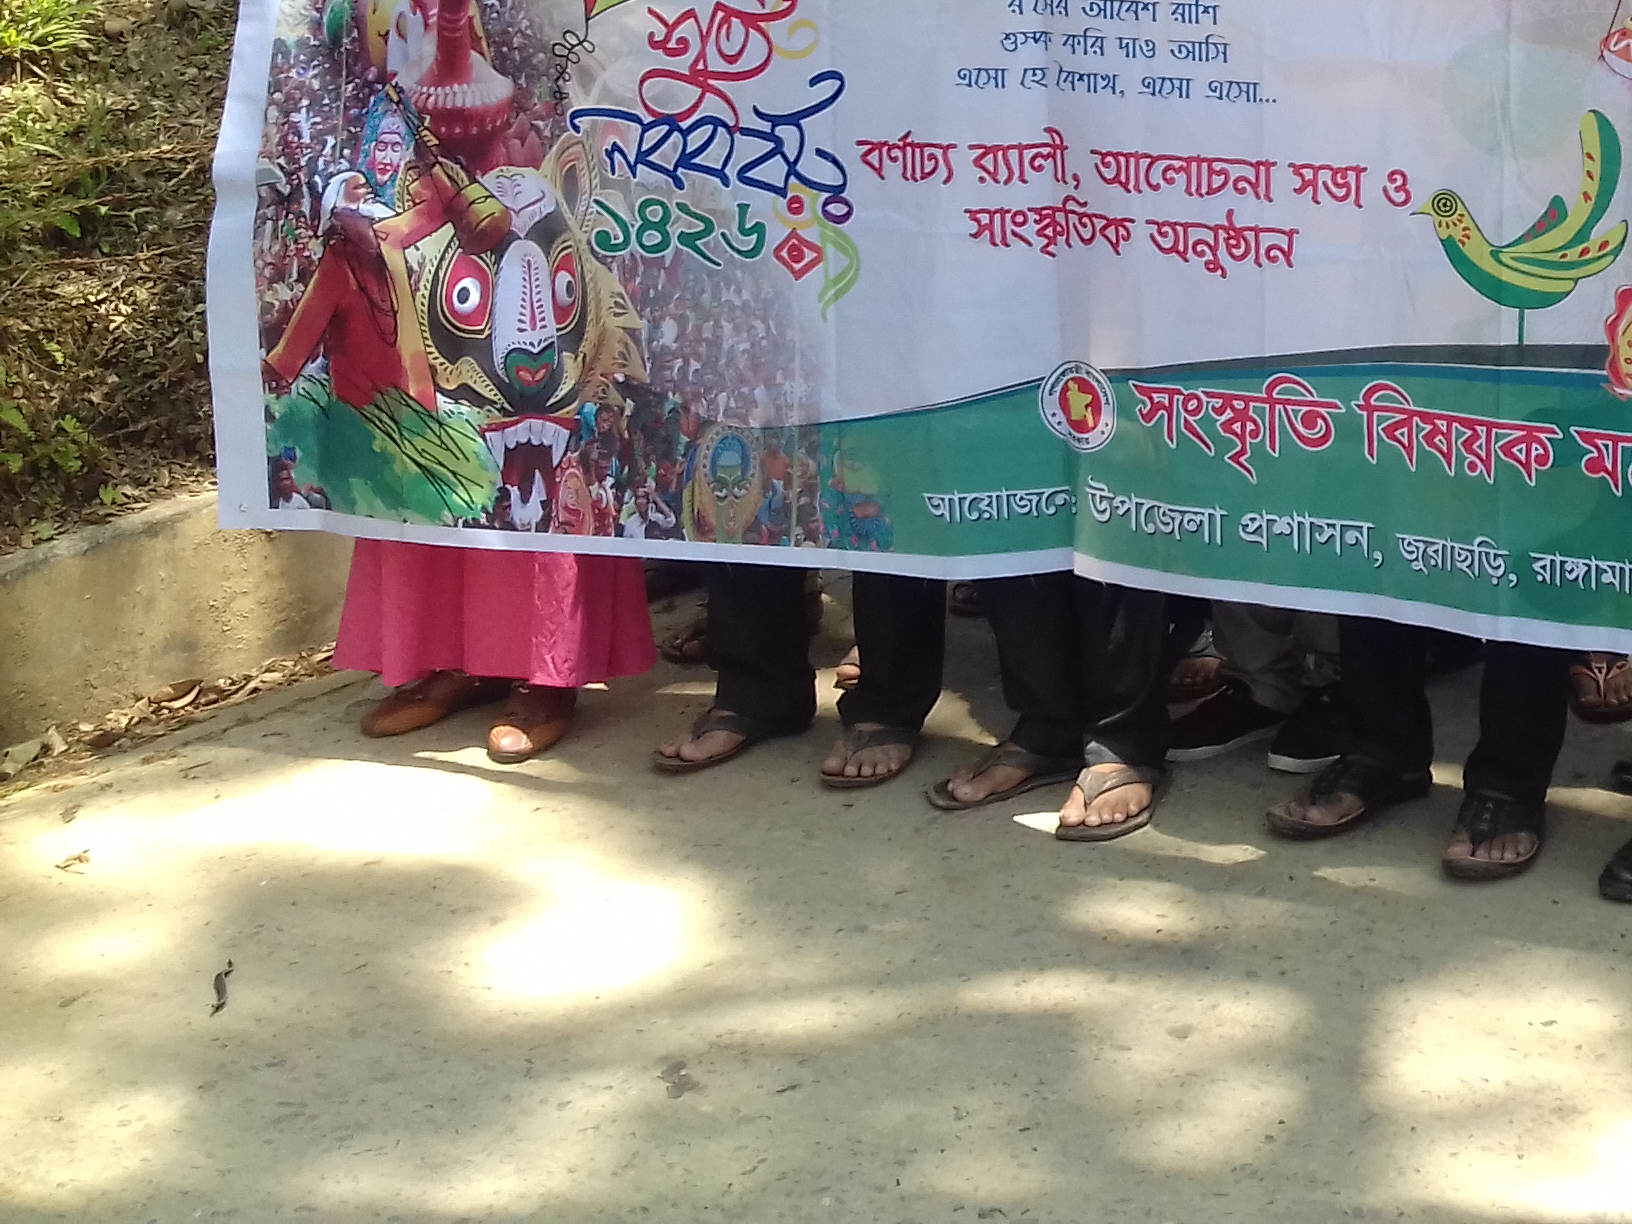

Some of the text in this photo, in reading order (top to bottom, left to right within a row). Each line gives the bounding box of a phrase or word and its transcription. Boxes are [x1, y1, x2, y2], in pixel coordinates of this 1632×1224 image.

[954, 66, 1009, 90] এসো
[1018, 67, 1050, 89] হে
[1055, 61, 1126, 98] বৈশাখ,
[1136, 76, 1194, 99] এসো
[1061, 27, 1109, 57] করি
[1115, 37, 1157, 58] দাও
[1166, 33, 1231, 64] আসি
[855, 129, 957, 186] বর্ণাঢ্য
[1090, 148, 1278, 204] আলোচনা
[1288, 161, 1369, 209] সভা
[1382, 167, 1414, 210] ও
[591, 195, 769, 269] ১৪২৬
[963, 195, 1300, 279] সাংস্কৃতিক অনুষ্ঠান
[1128, 373, 1346, 484] সংস্কৃতি
[1353, 381, 1564, 486] বিষয়ক
[922, 487, 1078, 523] আয়োজনে:
[1085, 476, 1228, 547] উপজেলা
[1238, 509, 1384, 568] প্রশাসন,
[1396, 532, 1519, 589] জুরাছড়ি,
